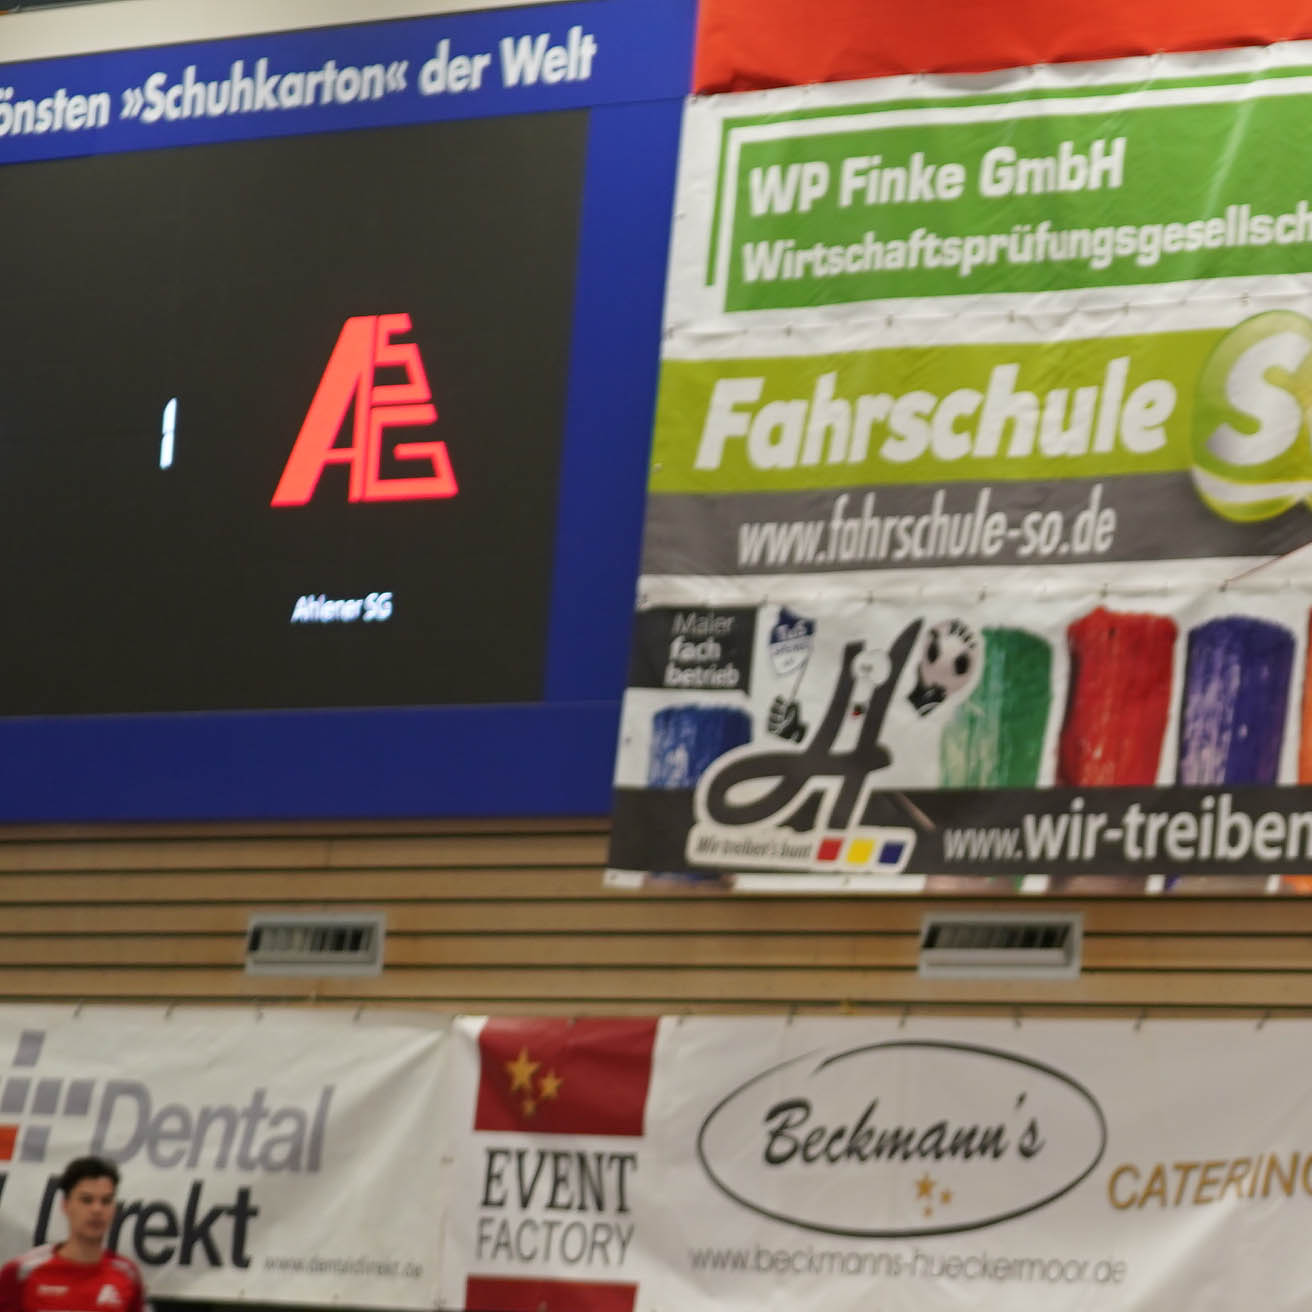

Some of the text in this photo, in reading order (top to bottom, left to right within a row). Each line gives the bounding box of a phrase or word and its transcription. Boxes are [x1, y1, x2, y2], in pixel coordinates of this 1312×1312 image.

[420, 40, 490, 94] der
[501, 27, 597, 86] Welt
[750, 136, 1128, 217] WP Finke GmbH
[694, 356, 1178, 471] Fahrschule
[737, 482, 1118, 566] www.fahrschule-so.de
[669, 635, 722, 663] fach
[671, 613, 735, 637] Maler
[664, 662, 741, 688] betrieb
[90, 1079, 336, 1174] Dental
[763, 1092, 1046, 1167] Beckmann's
[480, 1147, 638, 1213] EVENT
[475, 1216, 636, 1268] FACTORY
